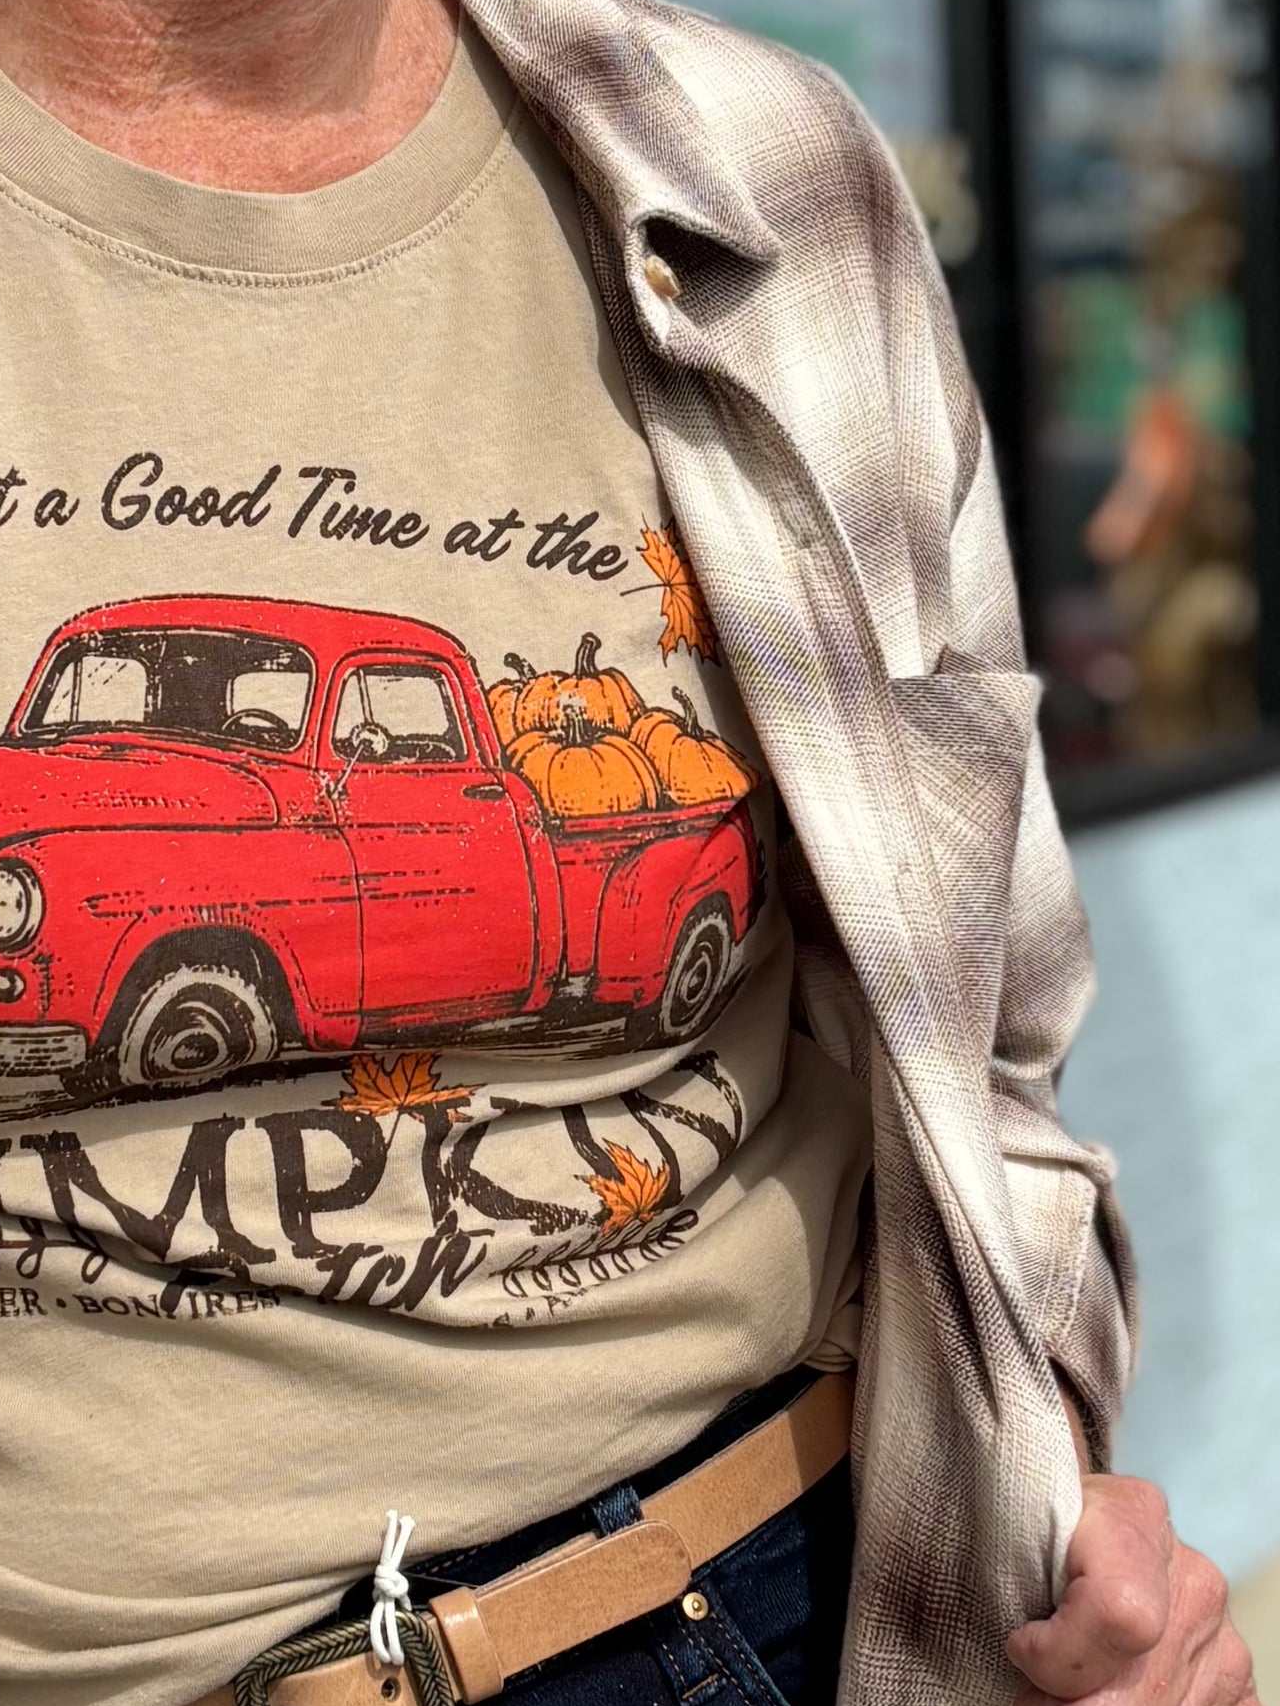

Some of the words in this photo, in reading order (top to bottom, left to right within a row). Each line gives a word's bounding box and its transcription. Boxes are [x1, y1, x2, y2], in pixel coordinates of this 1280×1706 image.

[33, 487, 80, 529] a
[100, 451, 282, 531] Good
[286, 466, 431, 549] Time
[443, 507, 525, 562] at
[526, 510, 629, 581] the
